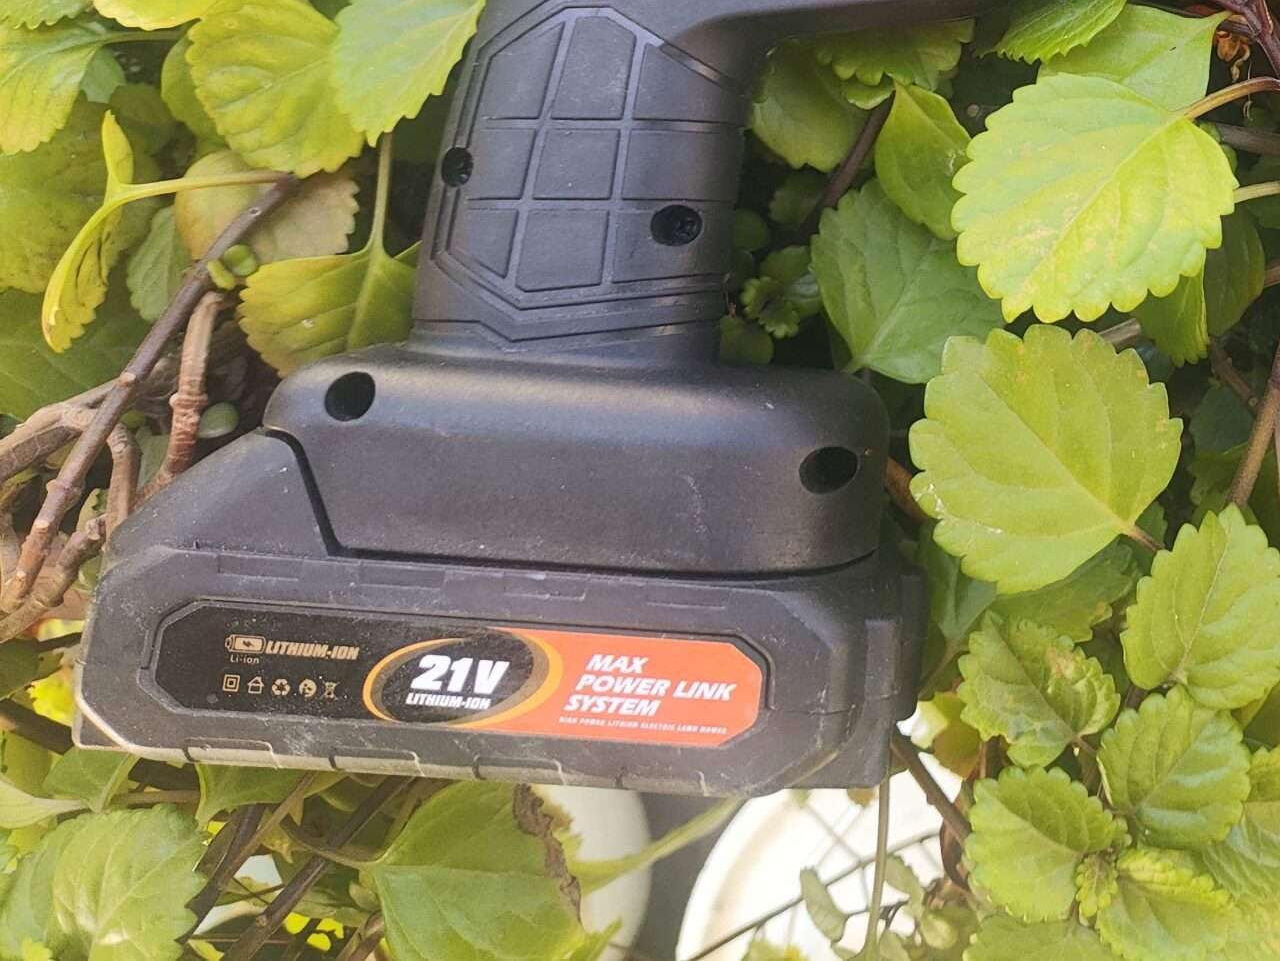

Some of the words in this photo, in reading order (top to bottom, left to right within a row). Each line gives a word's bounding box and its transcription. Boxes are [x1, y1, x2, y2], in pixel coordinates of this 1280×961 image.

[230, 654, 260, 665] Li-ion
[265, 640, 360, 660] LITHIUM-ION
[586, 654, 649, 674] MAX
[410, 654, 511, 695] 21V
[575, 674, 672, 697] POWER
[673, 680, 737, 701] LINK
[405, 692, 492, 710] LITHIUM-ION
[563, 694, 662, 716] SYSTEM
